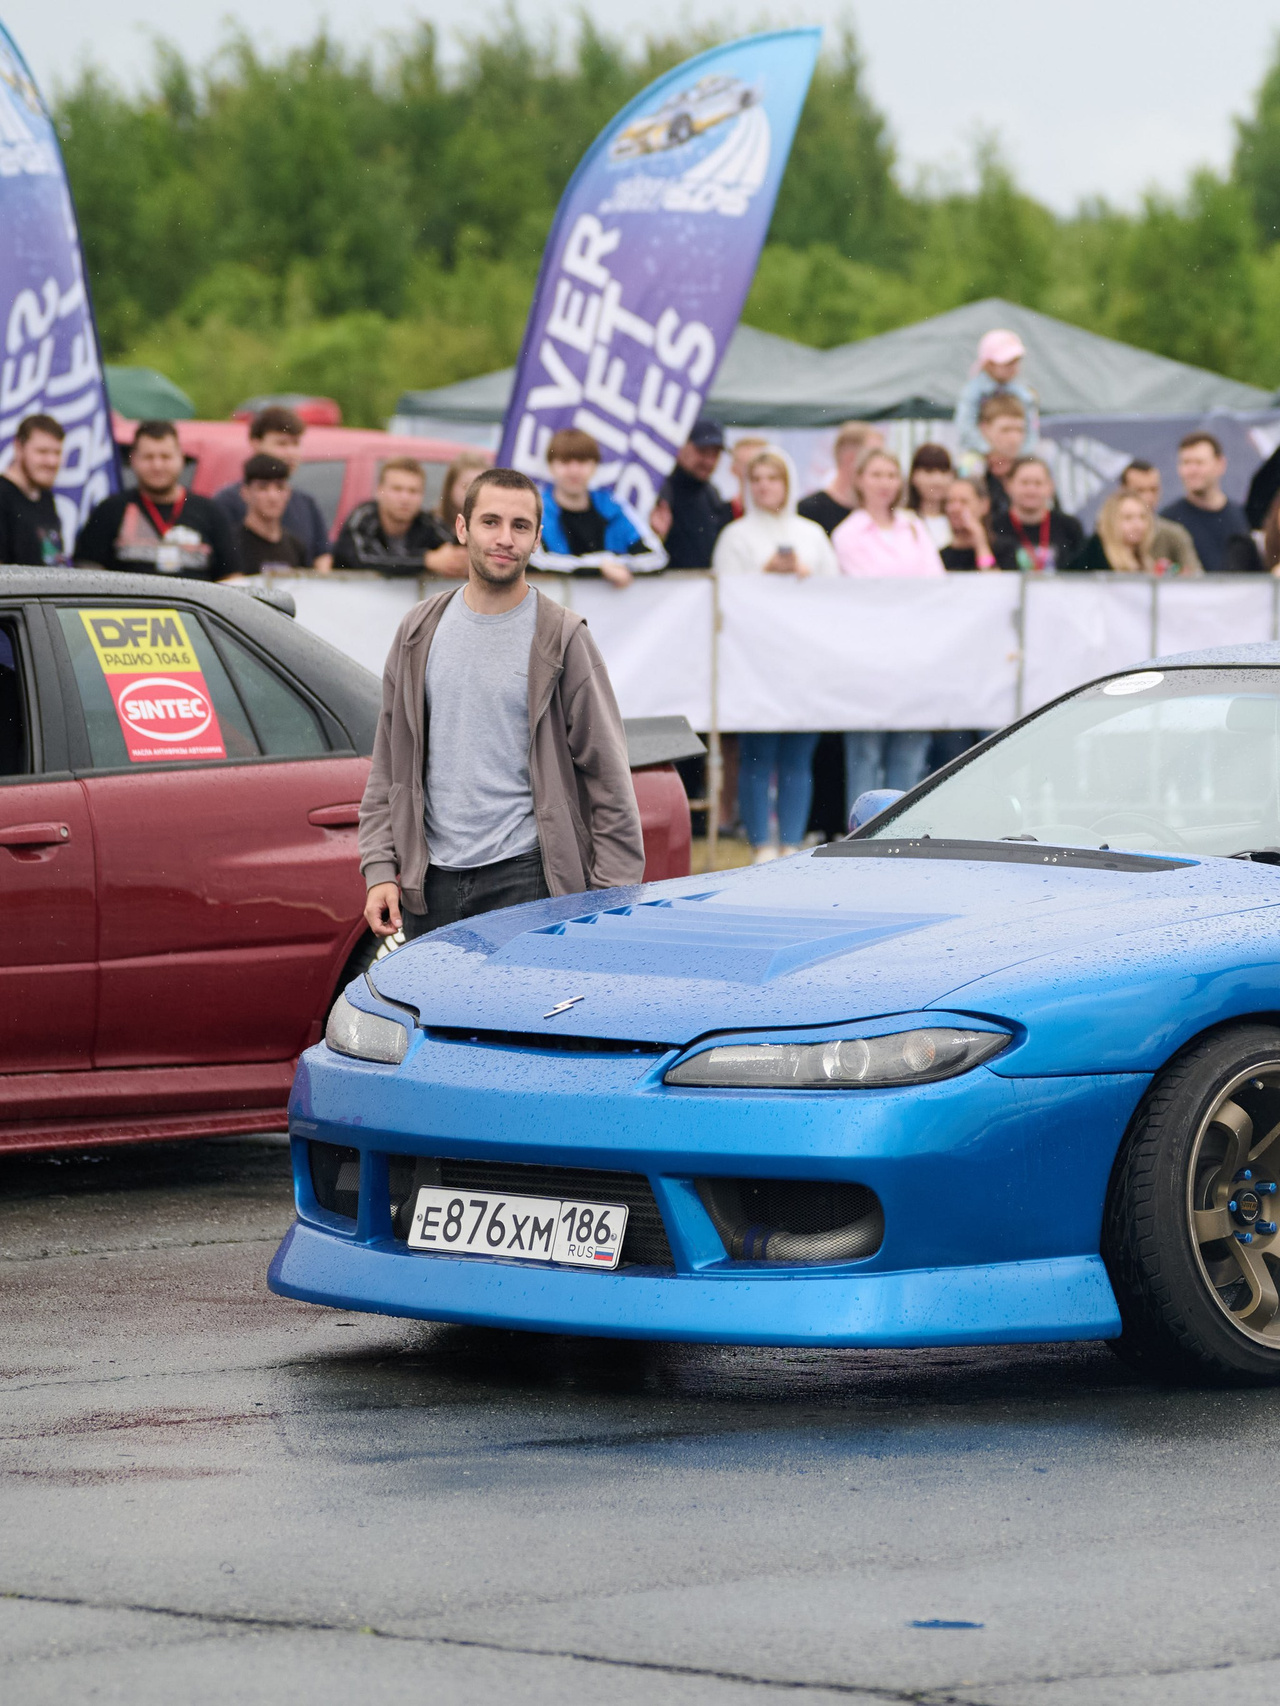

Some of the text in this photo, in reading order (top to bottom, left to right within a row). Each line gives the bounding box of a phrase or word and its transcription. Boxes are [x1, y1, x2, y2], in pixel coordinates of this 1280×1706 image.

[90, 617, 185, 648] DFM
[104, 652, 191, 666] РАДИО 104.6
[125, 698, 206, 720] SINTEC
[562, 1207, 611, 1244] 186
[568, 1244, 593, 1258] RUS
